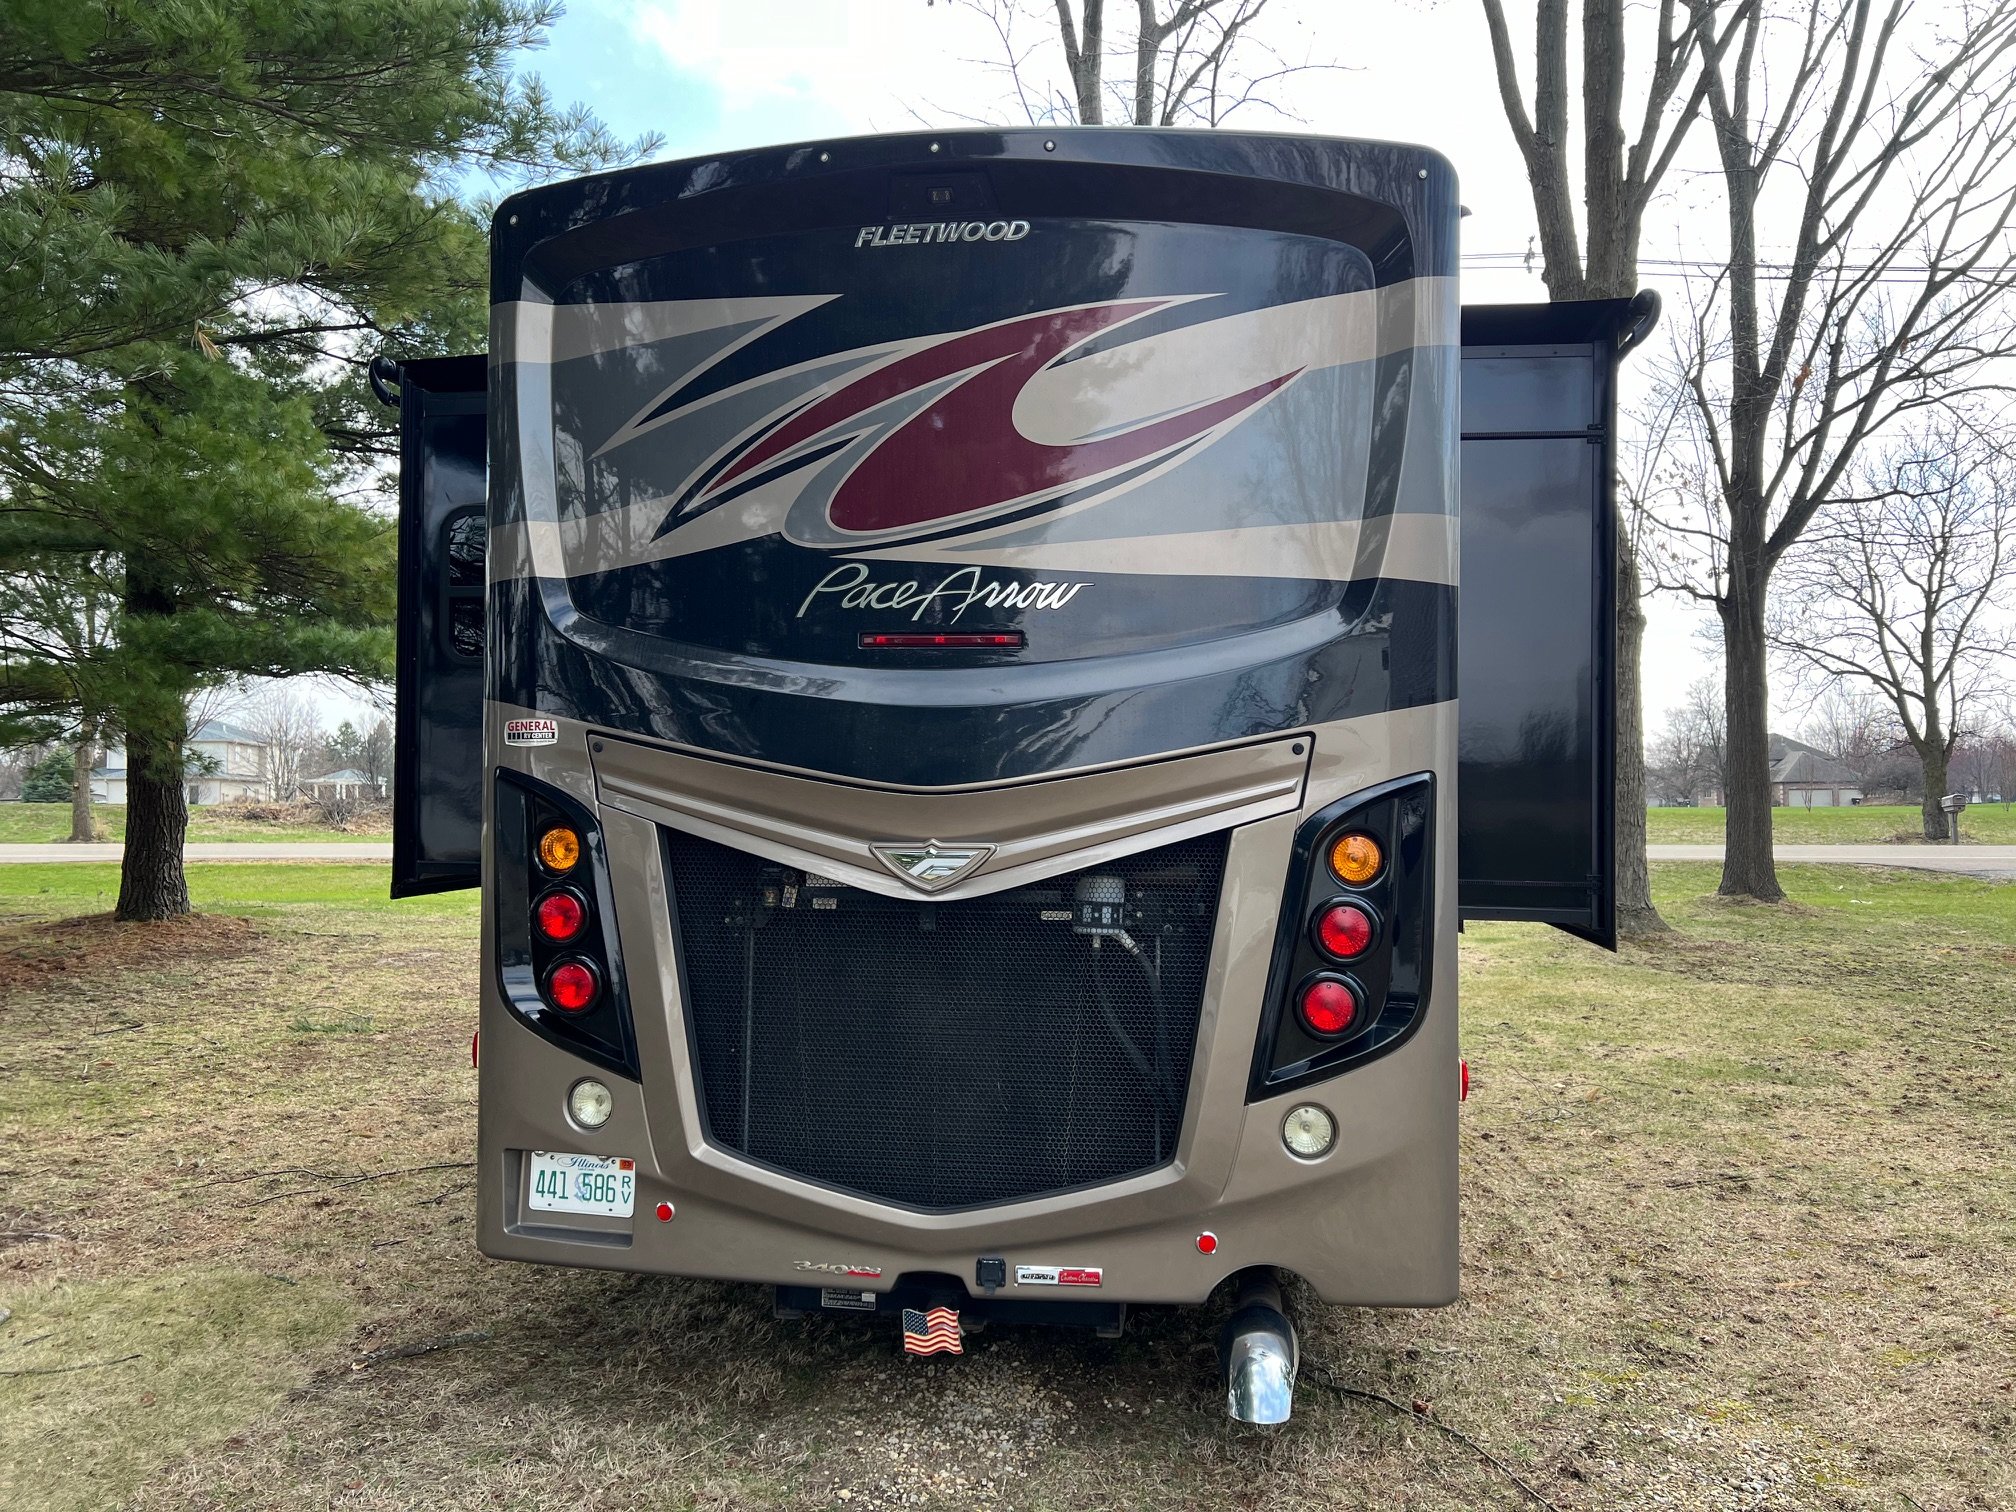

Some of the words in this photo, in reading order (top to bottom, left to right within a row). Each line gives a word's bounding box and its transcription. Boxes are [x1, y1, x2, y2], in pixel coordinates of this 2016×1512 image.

[854, 220, 1031, 248] FLEETWOOD
[796, 563, 920, 619] Pace
[911, 566, 1095, 624] Arrow
[507, 720, 556, 732] GENERAL
[557, 1156, 610, 1170] Illinois
[535, 1169, 569, 1199] 441
[582, 1172, 617, 1203] 586
